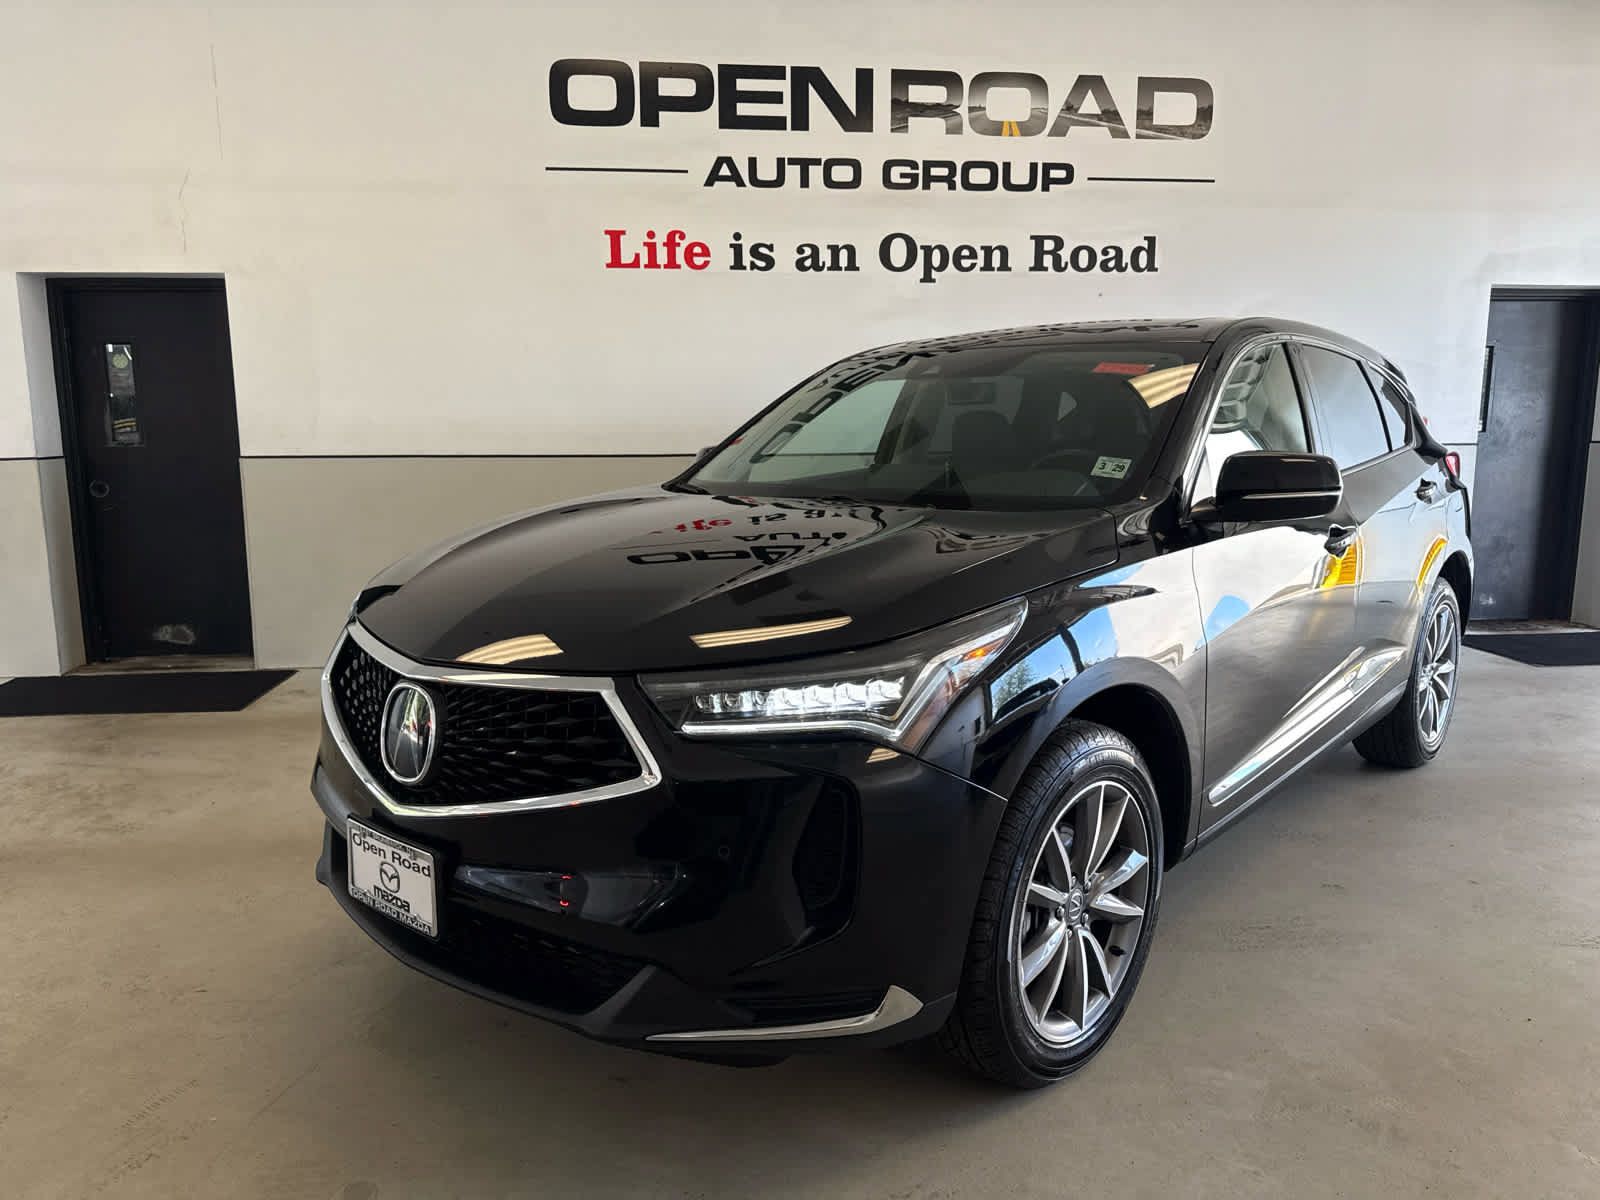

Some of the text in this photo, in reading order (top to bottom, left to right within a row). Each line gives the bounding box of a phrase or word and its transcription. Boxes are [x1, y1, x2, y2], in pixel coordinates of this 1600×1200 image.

[549, 58, 1214, 140] OPEN ROAD
[703, 156, 1075, 193] AUTO GROUP
[604, 229, 1159, 284] Life is an Open Road
[352, 832, 387, 860] Open
[391, 850, 431, 878] Road
[400, 911, 432, 935] MAZDA
